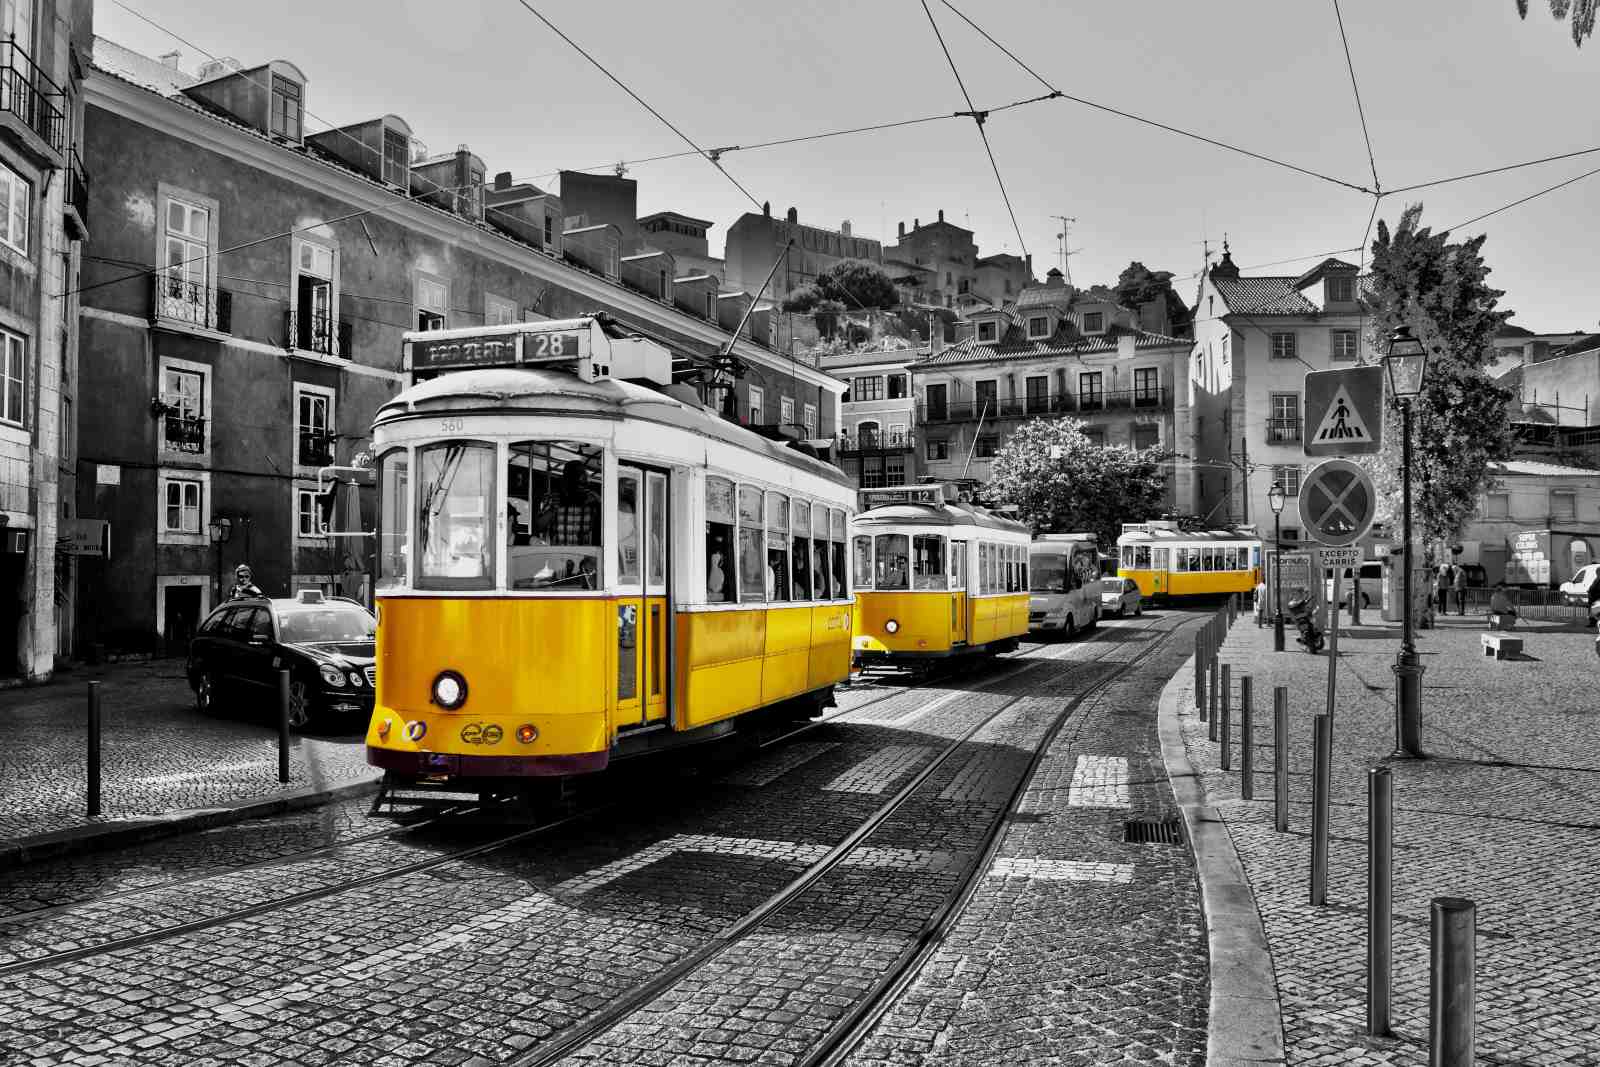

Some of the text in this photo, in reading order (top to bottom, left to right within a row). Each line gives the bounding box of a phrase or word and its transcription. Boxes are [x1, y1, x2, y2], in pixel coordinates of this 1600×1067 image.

[535, 335, 564, 357] 28
[441, 419, 464, 431] 560
[1323, 558, 1356, 566] CARRIS
